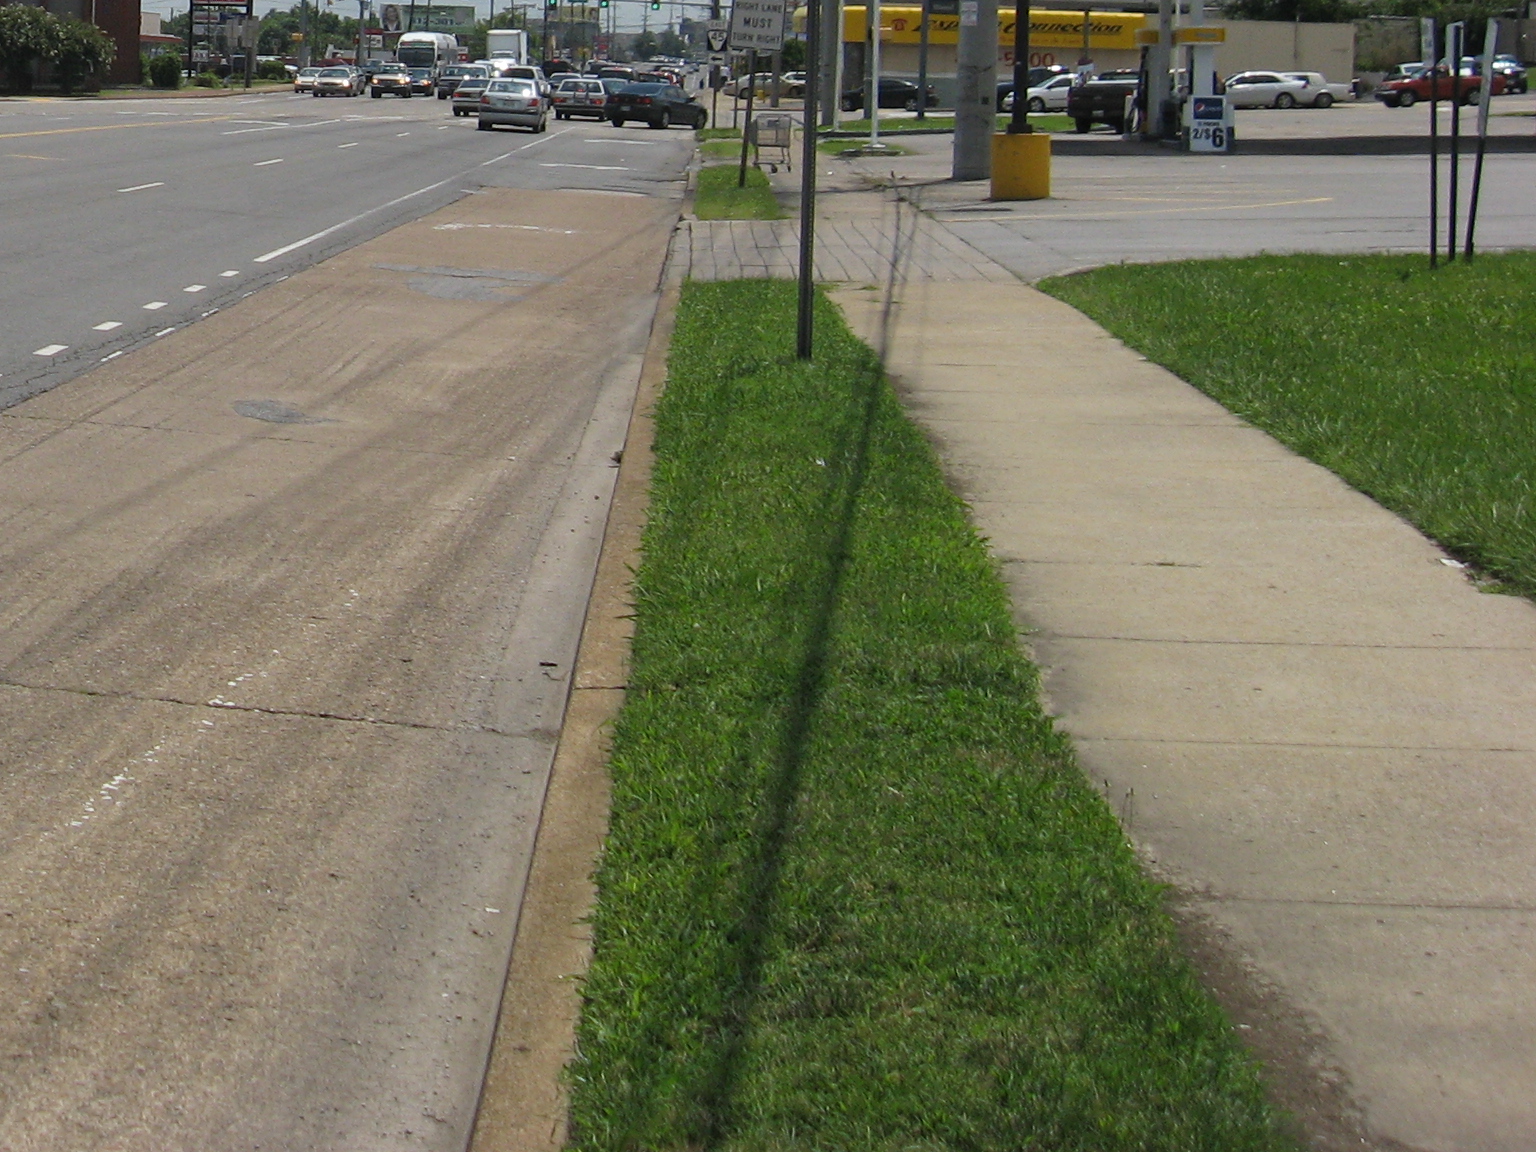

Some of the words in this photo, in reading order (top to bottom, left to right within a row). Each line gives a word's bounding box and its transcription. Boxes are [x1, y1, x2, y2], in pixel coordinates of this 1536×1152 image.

[761, 4, 783, 13] LANE
[743, 17, 773, 28] MUST
[732, 32, 754, 41] TURN
[756, 34, 781, 44] RIGHT
